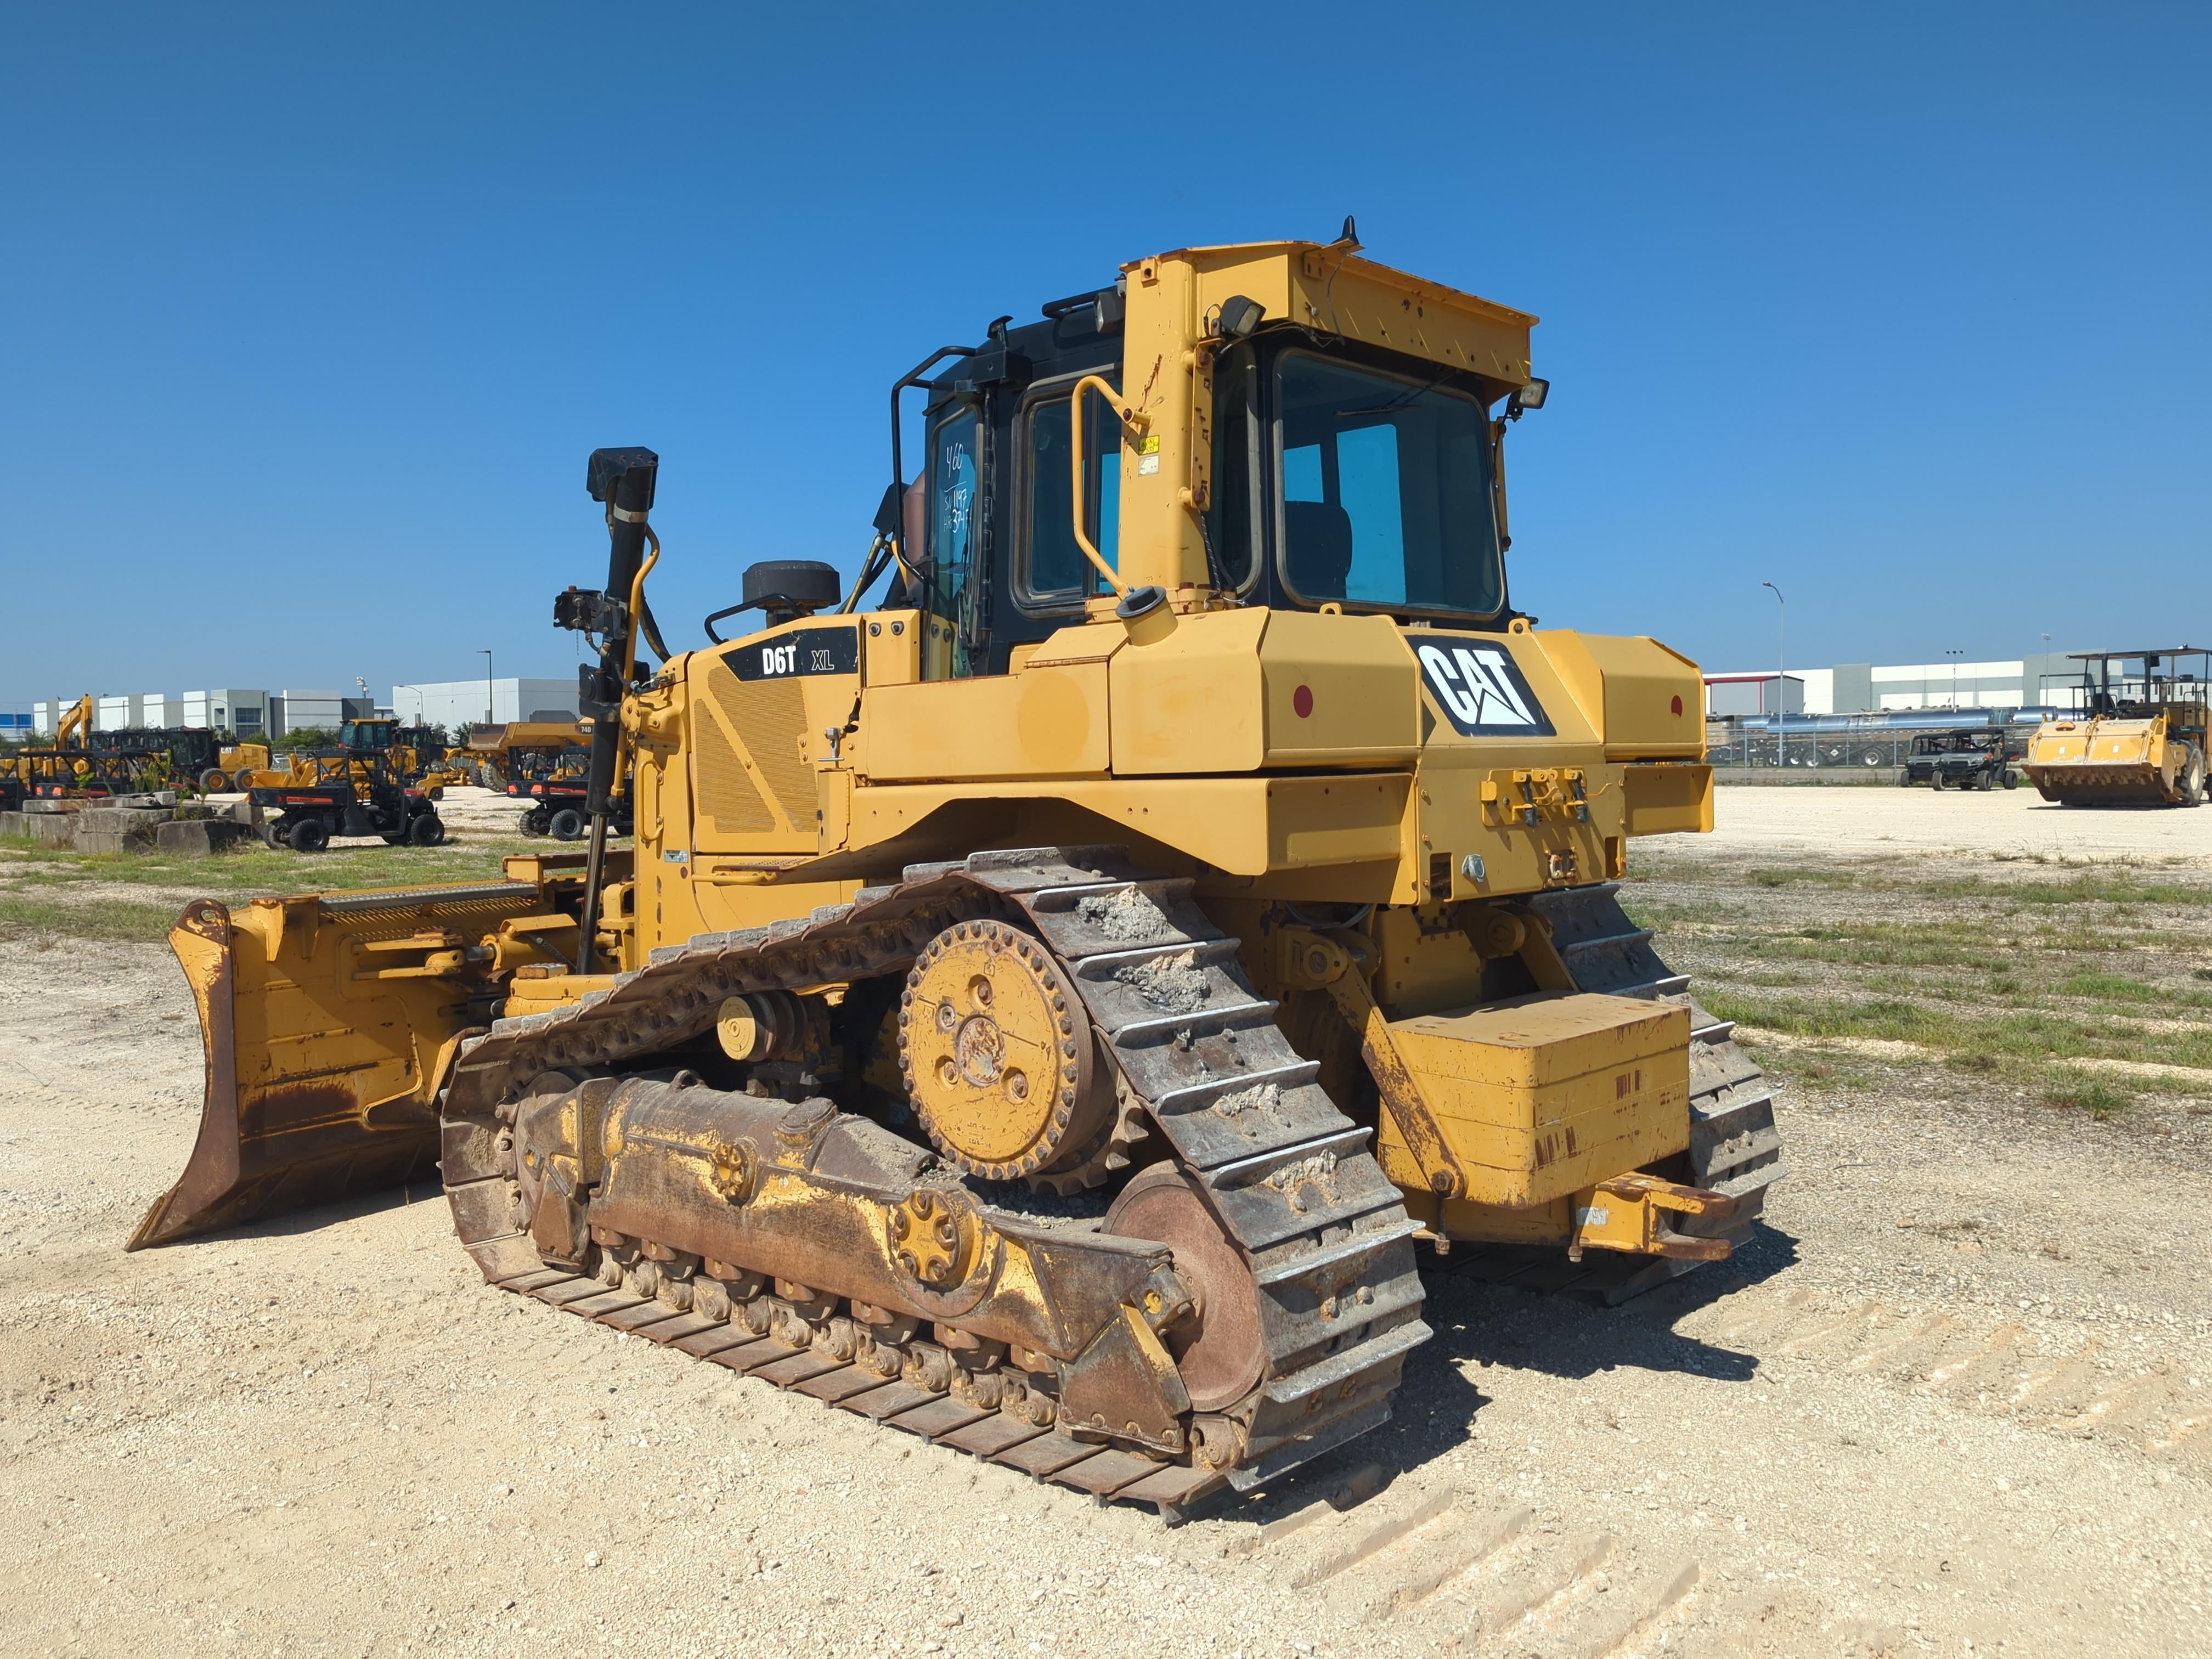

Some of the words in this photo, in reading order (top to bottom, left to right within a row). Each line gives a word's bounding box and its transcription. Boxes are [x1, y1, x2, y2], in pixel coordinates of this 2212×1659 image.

[946, 442, 963, 478] 460
[763, 646, 796, 675] D6T
[811, 650, 834, 671] XL
[1418, 645, 1536, 725] CAT
